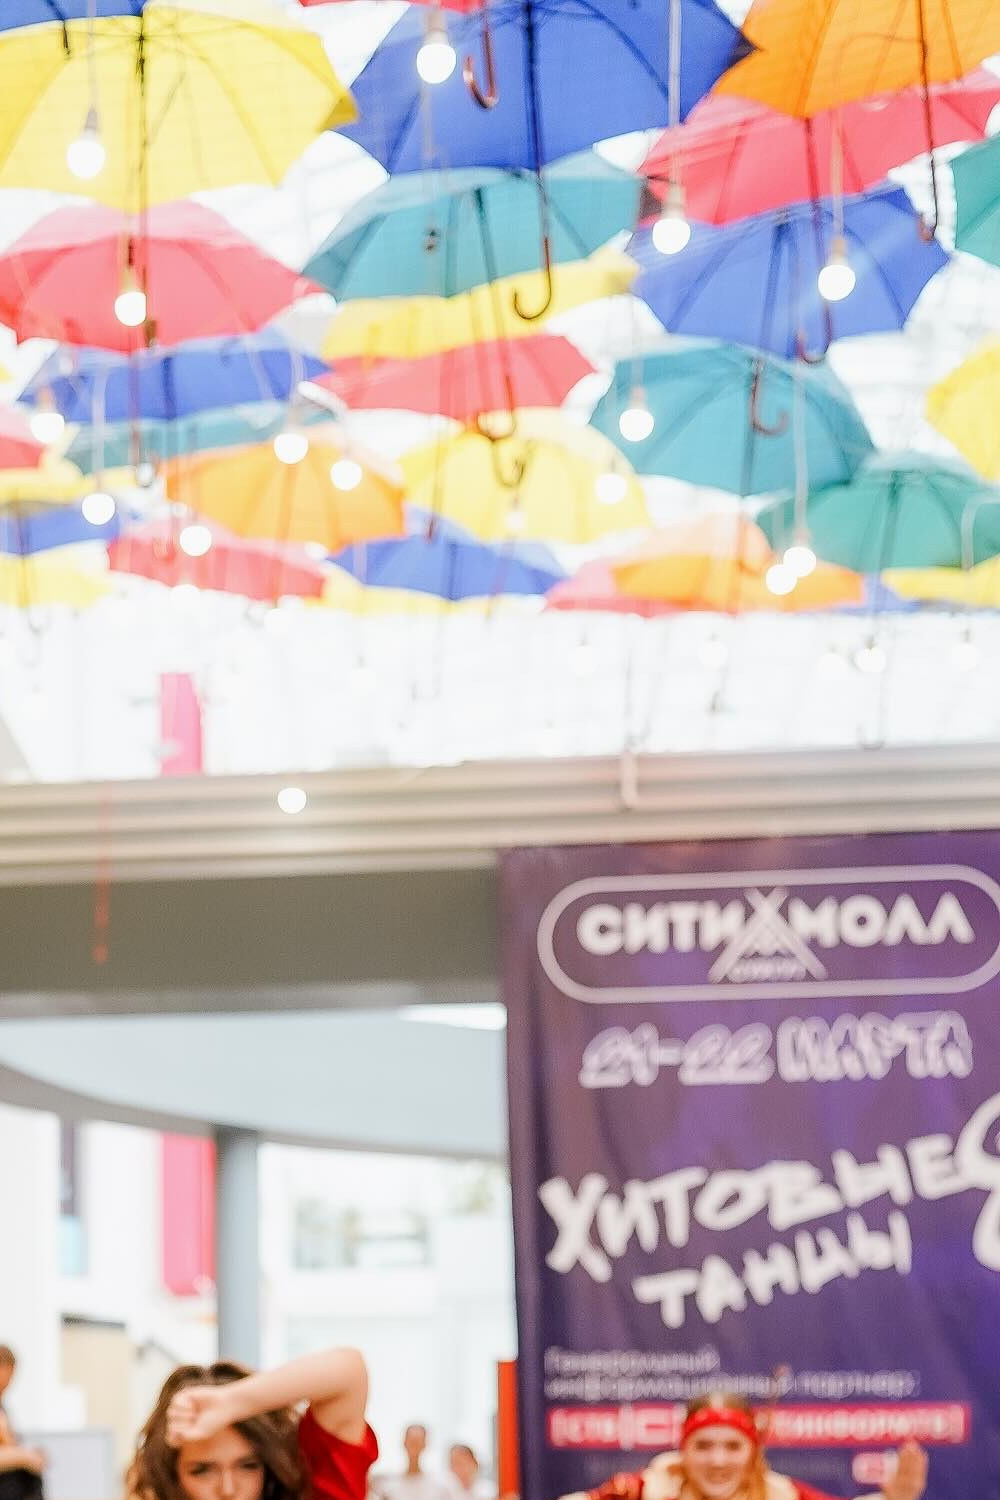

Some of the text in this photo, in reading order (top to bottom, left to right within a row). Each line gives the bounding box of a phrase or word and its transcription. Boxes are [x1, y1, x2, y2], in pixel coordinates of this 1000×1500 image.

[577, 890, 976, 955] СИТИ МОЛЛ
[578, 1009, 974, 1088] 21-22 МАРТА
[538, 1132, 959, 1283] ХИТОВЫЕ
[631, 1208, 913, 1329] ТАНЦЫ
